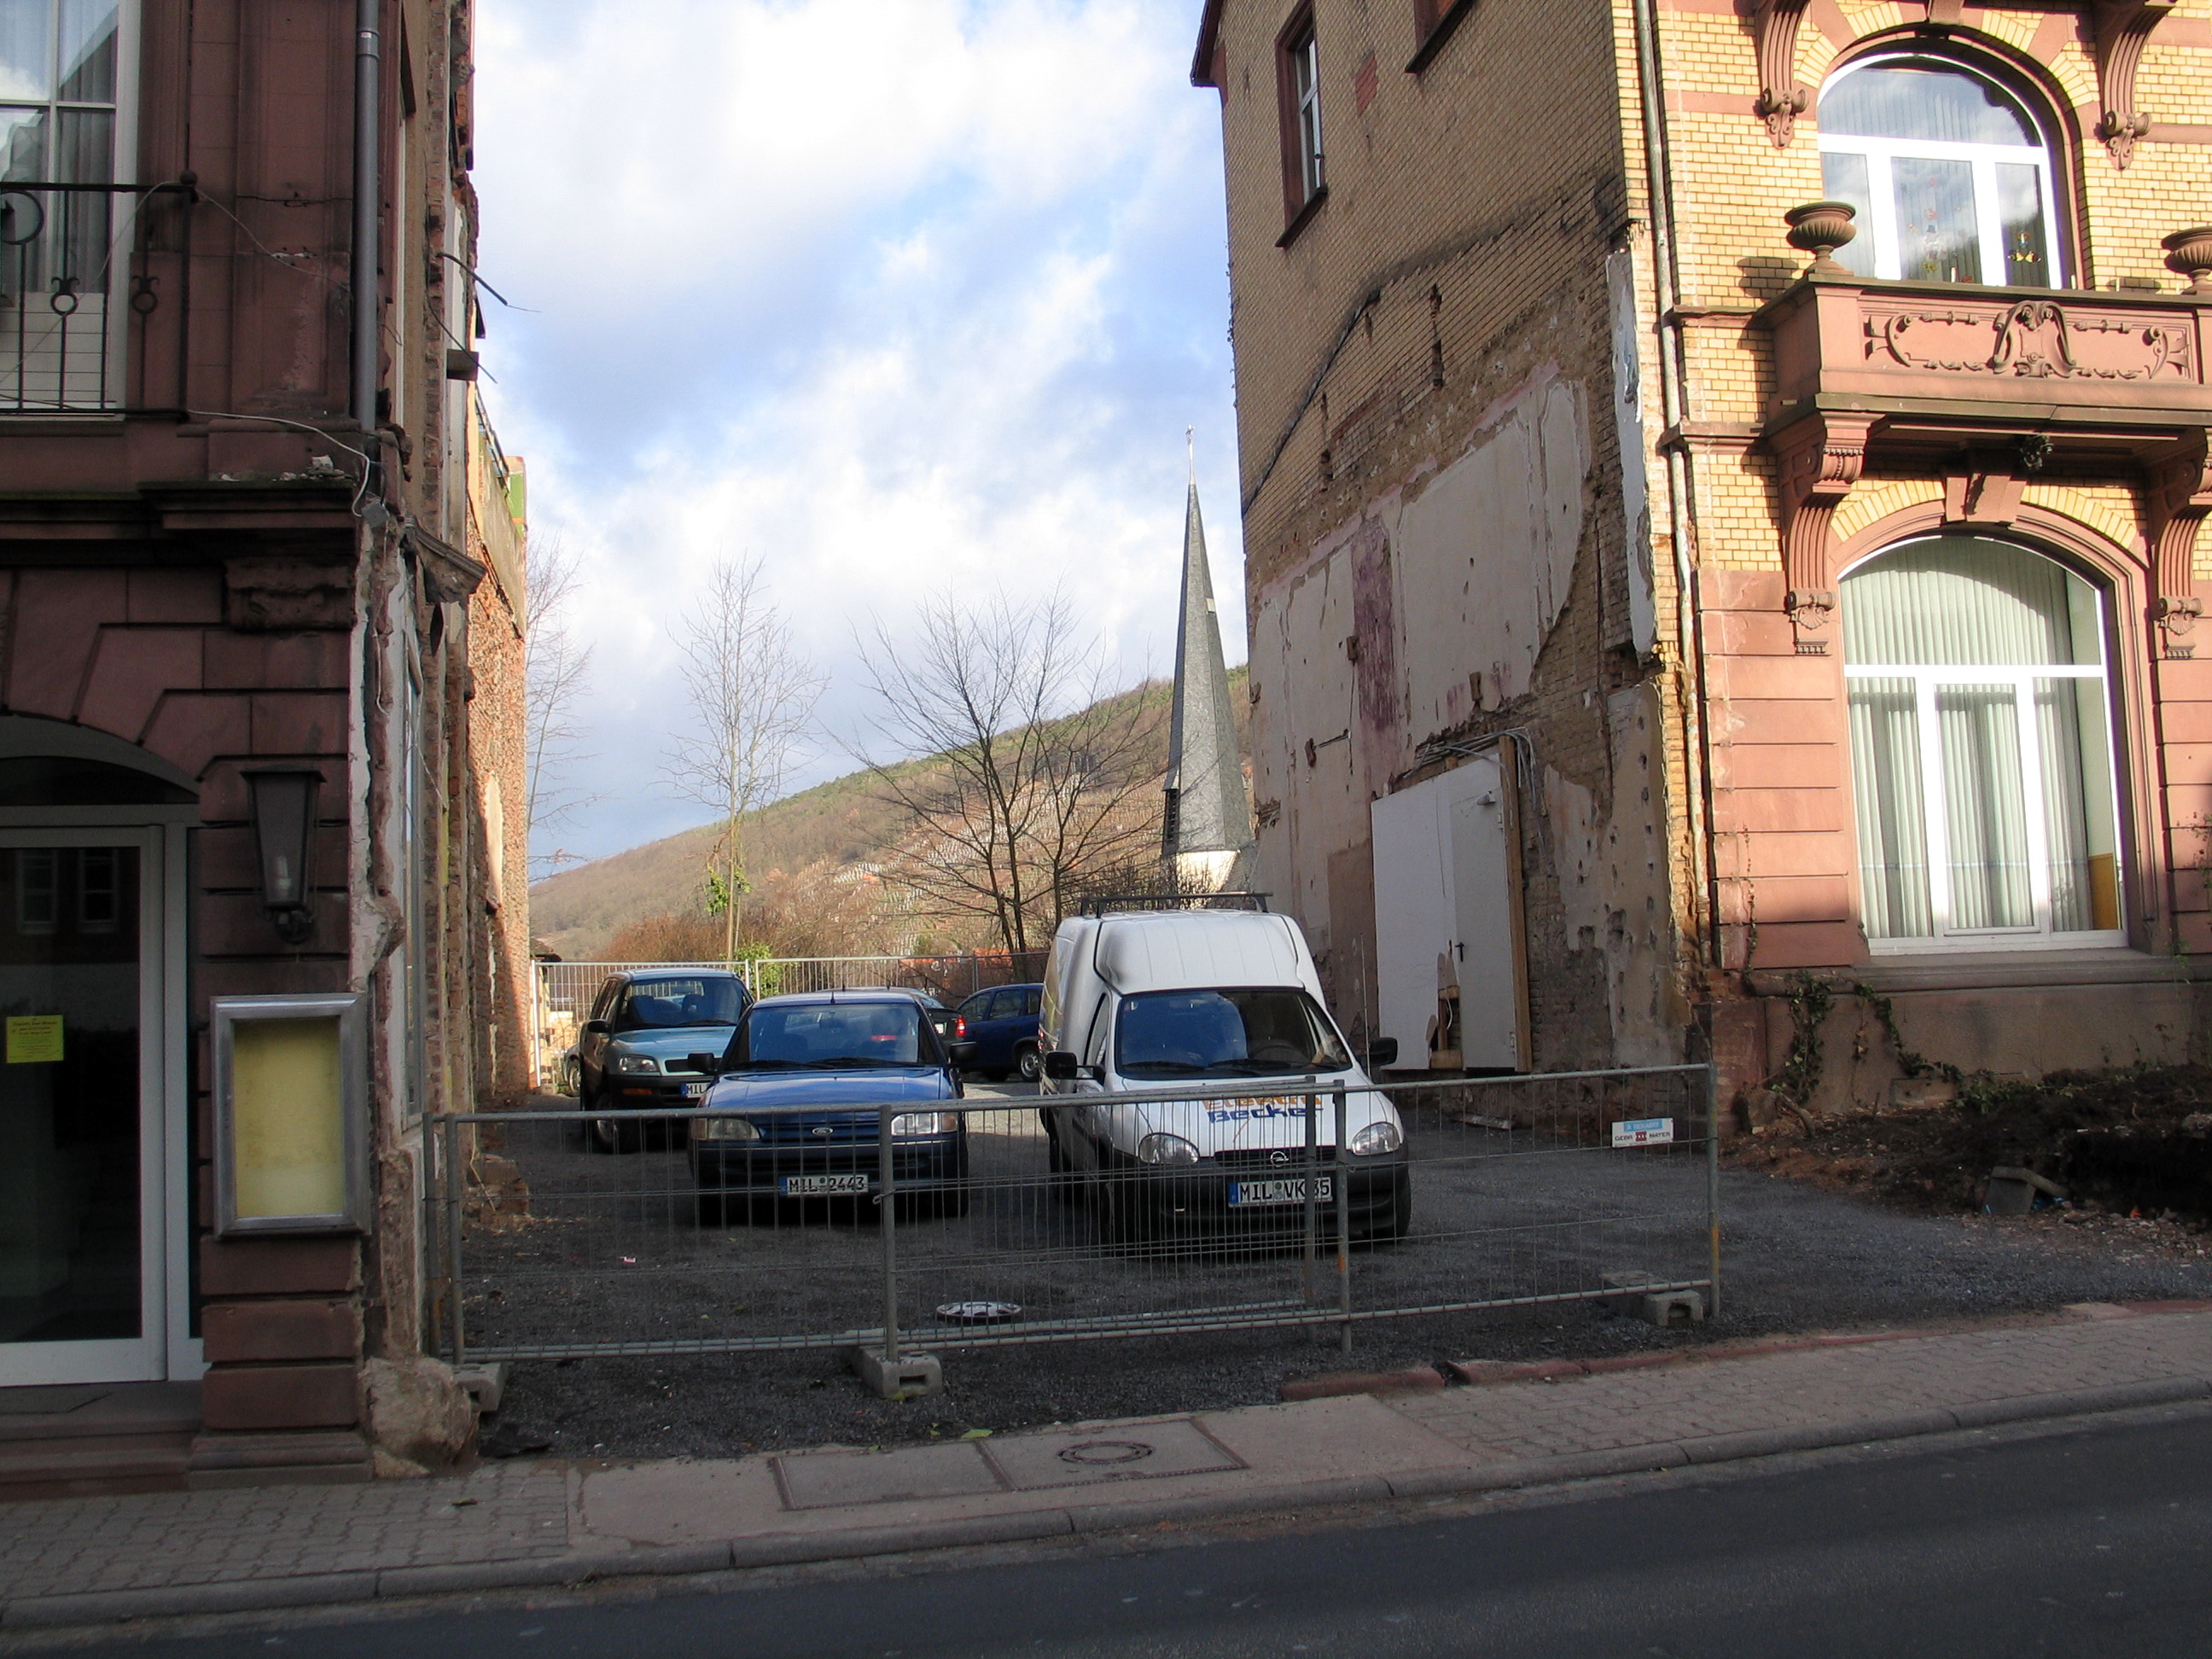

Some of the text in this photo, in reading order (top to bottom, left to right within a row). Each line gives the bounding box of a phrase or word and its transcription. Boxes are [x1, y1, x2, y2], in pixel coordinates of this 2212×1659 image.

[686, 1084, 707, 1094] MIL
[789, 1176, 865, 1193] MIL 2443
[1240, 1182, 1272, 1202] MIL
[1284, 1180, 1306, 1198] VK
